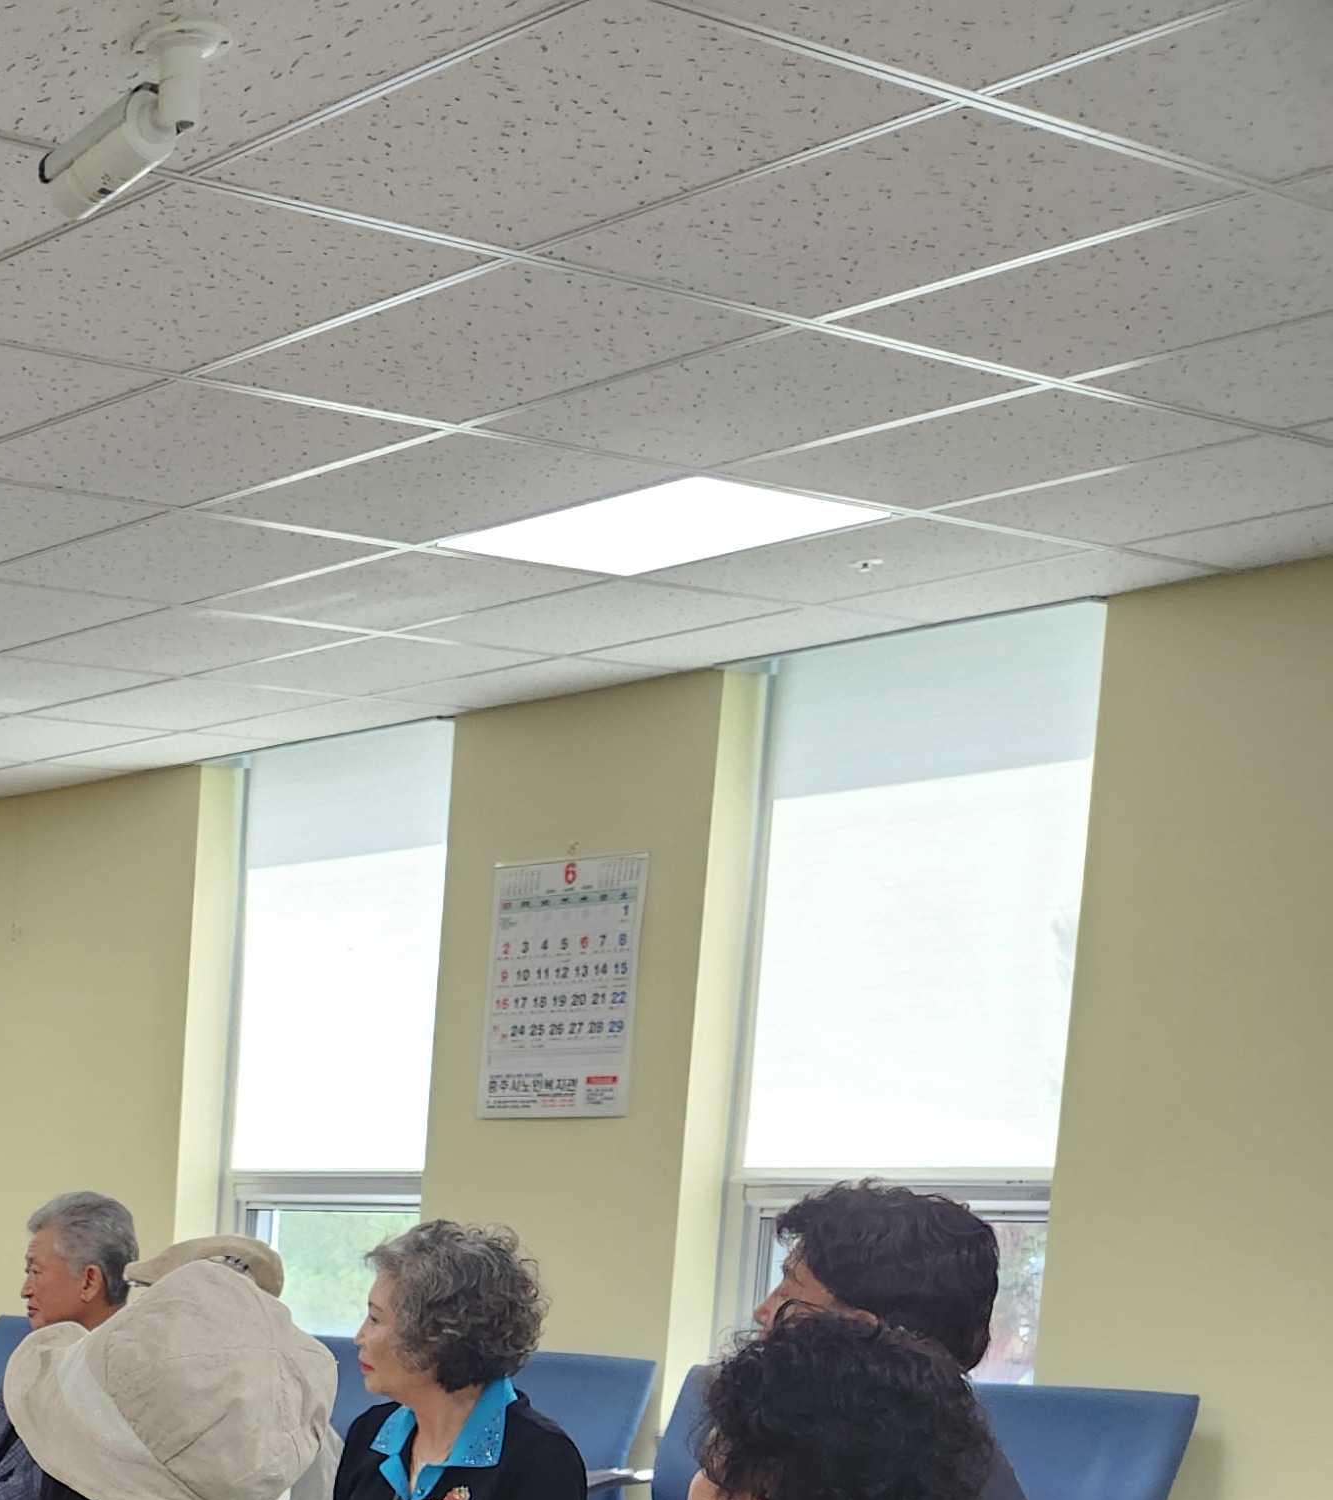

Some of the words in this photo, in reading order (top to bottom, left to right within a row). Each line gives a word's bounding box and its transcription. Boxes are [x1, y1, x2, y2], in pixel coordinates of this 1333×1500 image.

[564, 863, 577, 885] 6
[522, 941, 530, 954] 3
[541, 939, 549, 951] 4
[560, 937, 569, 950] 5
[599, 934, 607, 947] 7
[516, 969, 531, 982] 10
[536, 967, 550, 980] 11
[555, 966, 570, 979] 12
[574, 964, 589, 978] 13
[594, 962, 609, 976] 14
[614, 961, 629, 975] 15
[514, 996, 528, 1009] 17
[533, 995, 548, 1009] 18
[553, 994, 567, 1007] 19
[571, 993, 587, 1007] 20
[592, 992, 606, 1005] 21
[612, 991, 628, 1005] 22
[510, 1024, 526, 1038] 24
[529, 1023, 546, 1037] 25
[549, 1022, 565, 1036] 26
[568, 1021, 585, 1035] 27
[608, 1019, 625, 1033] 29
